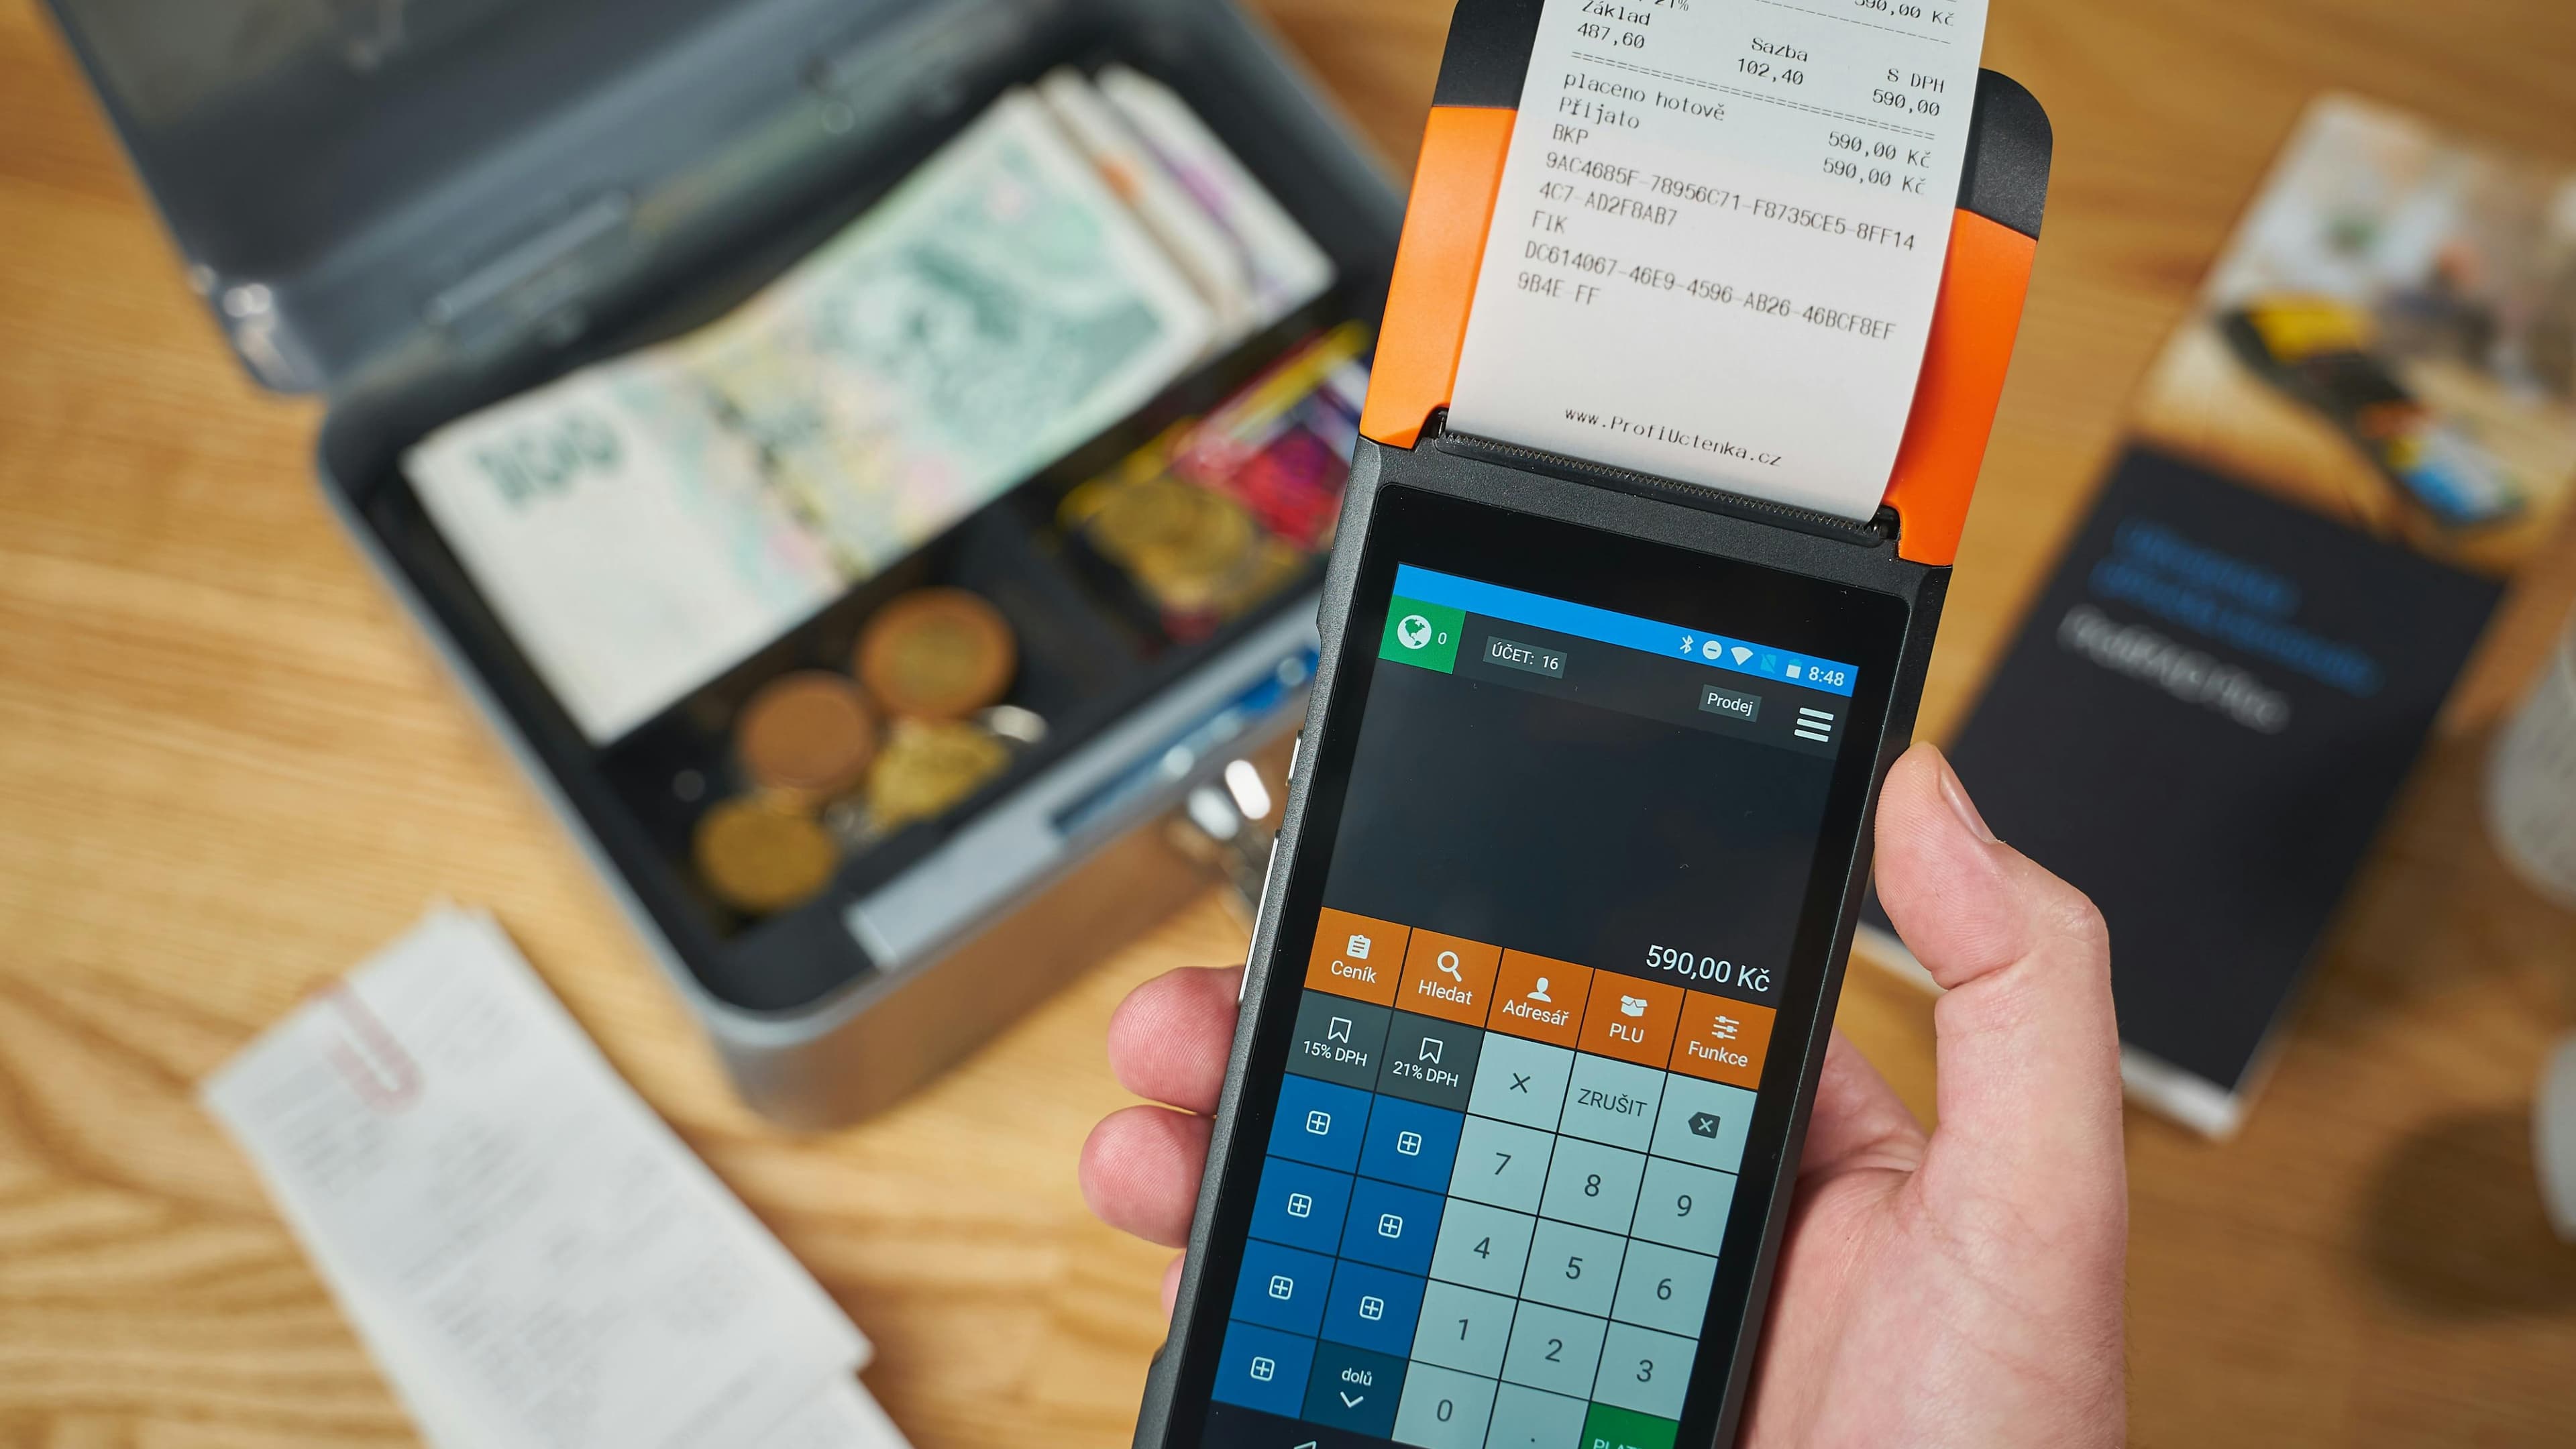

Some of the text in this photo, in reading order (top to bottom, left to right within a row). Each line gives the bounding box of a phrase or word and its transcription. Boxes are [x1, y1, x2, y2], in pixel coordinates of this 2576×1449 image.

[1932, 10, 1954, 26] Kč
[1582, 0, 1945, 93] Základ Sazba S DPH
[1577, 22, 1940, 116] 487,60 102,40 590,00
[1563, 72, 1931, 168] placeno hotově 590,00 Kč
[1552, 123, 1589, 145] BKP
[1559, 96, 1927, 195] Přijato 590,00 Kč
[1532, 209, 1568, 233] FIK
[1564, 407, 1782, 467] www.ProfiUctenka.cz
[1438, 632, 1448, 645] 0
[1491, 641, 1559, 670] ÚČET: 16
[1808, 666, 1845, 687] 8:48
[1707, 692, 1754, 716] Prodej
[1331, 960, 1377, 983] Ceník
[1646, 944, 1770, 992] 590,00 Kč
[1417, 979, 1473, 1005] Hledat
[1502, 999, 1570, 1026] Adresář
[1609, 1022, 1644, 1043] PLU
[1303, 1040, 1368, 1067] 15% DPH
[1688, 1040, 1748, 1067] Funkce
[1393, 1061, 1459, 1087] 21% DPH
[1577, 1088, 1648, 1117] ZRUŠIT
[1495, 1152, 1511, 1175] 7
[1584, 1174, 1601, 1197] 8
[1677, 1194, 1693, 1217] 9
[1473, 1237, 1491, 1259] 4
[1566, 1256, 1583, 1280] 5
[1656, 1277, 1672, 1301] 6
[1458, 1318, 1469, 1340] 1
[1545, 1338, 1562, 1362] 2
[1341, 1366, 1373, 1386] dolů
[1636, 1359, 1654, 1383] 3
[1436, 1399, 1453, 1422] 0
